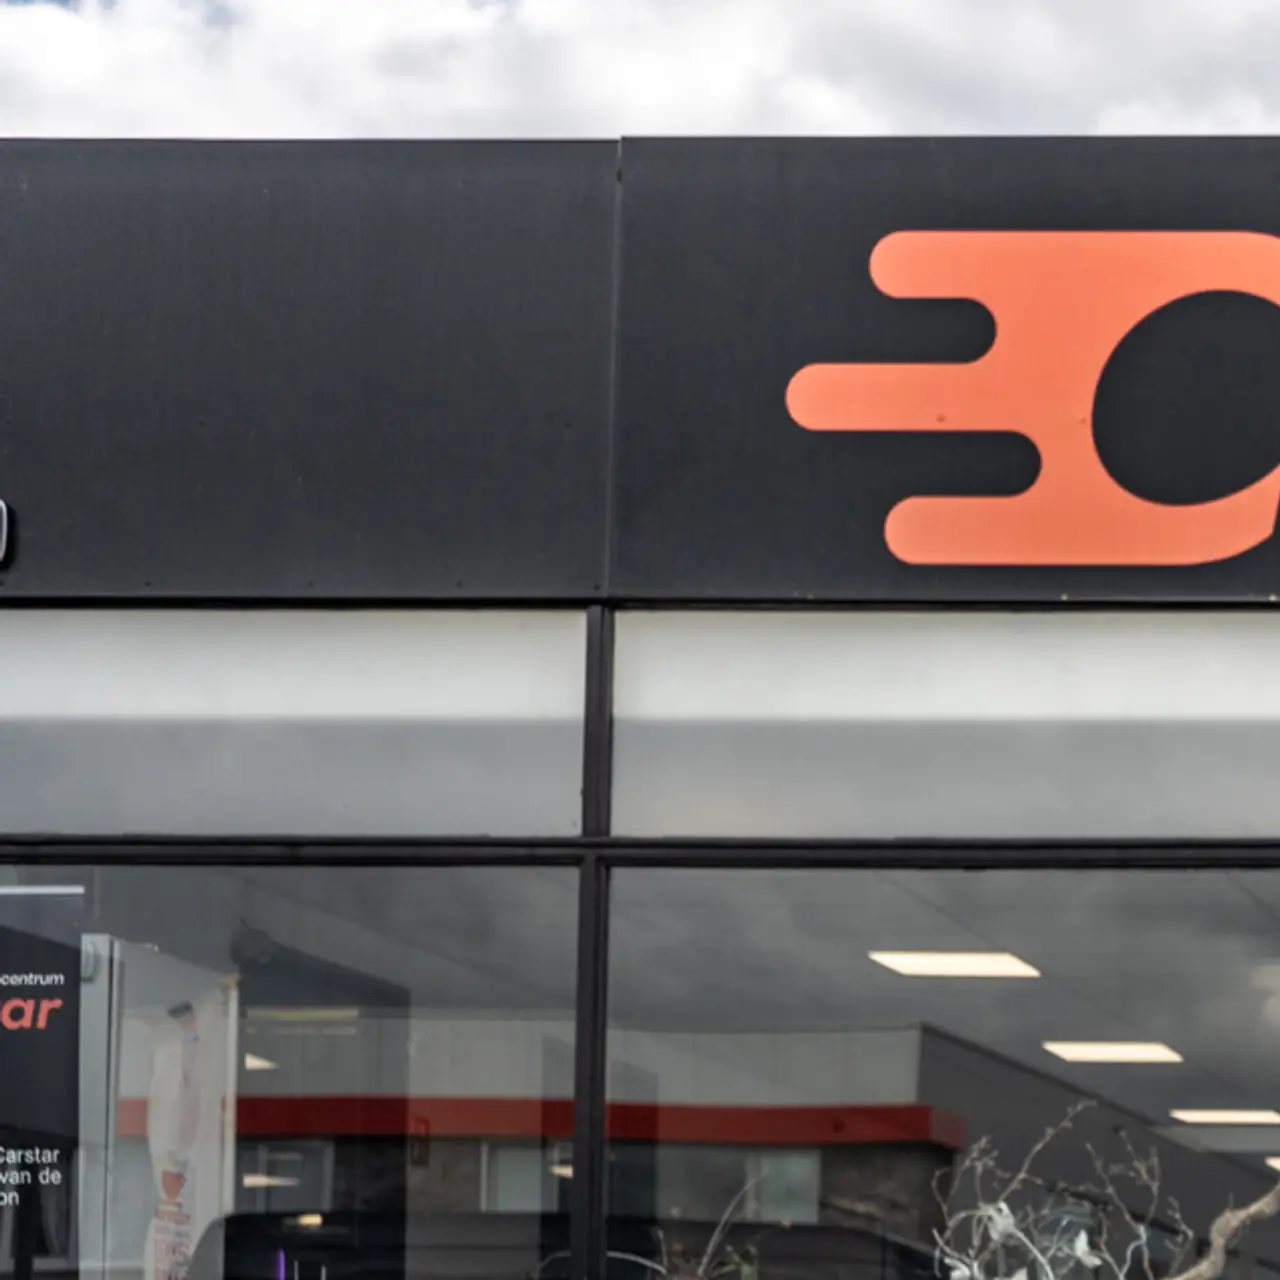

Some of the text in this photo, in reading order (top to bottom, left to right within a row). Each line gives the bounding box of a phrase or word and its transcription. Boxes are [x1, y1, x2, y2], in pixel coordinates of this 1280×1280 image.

[0, 973, 65, 986] centrum
[0, 997, 63, 1031] ar
[39, 1166, 62, 1185] de
